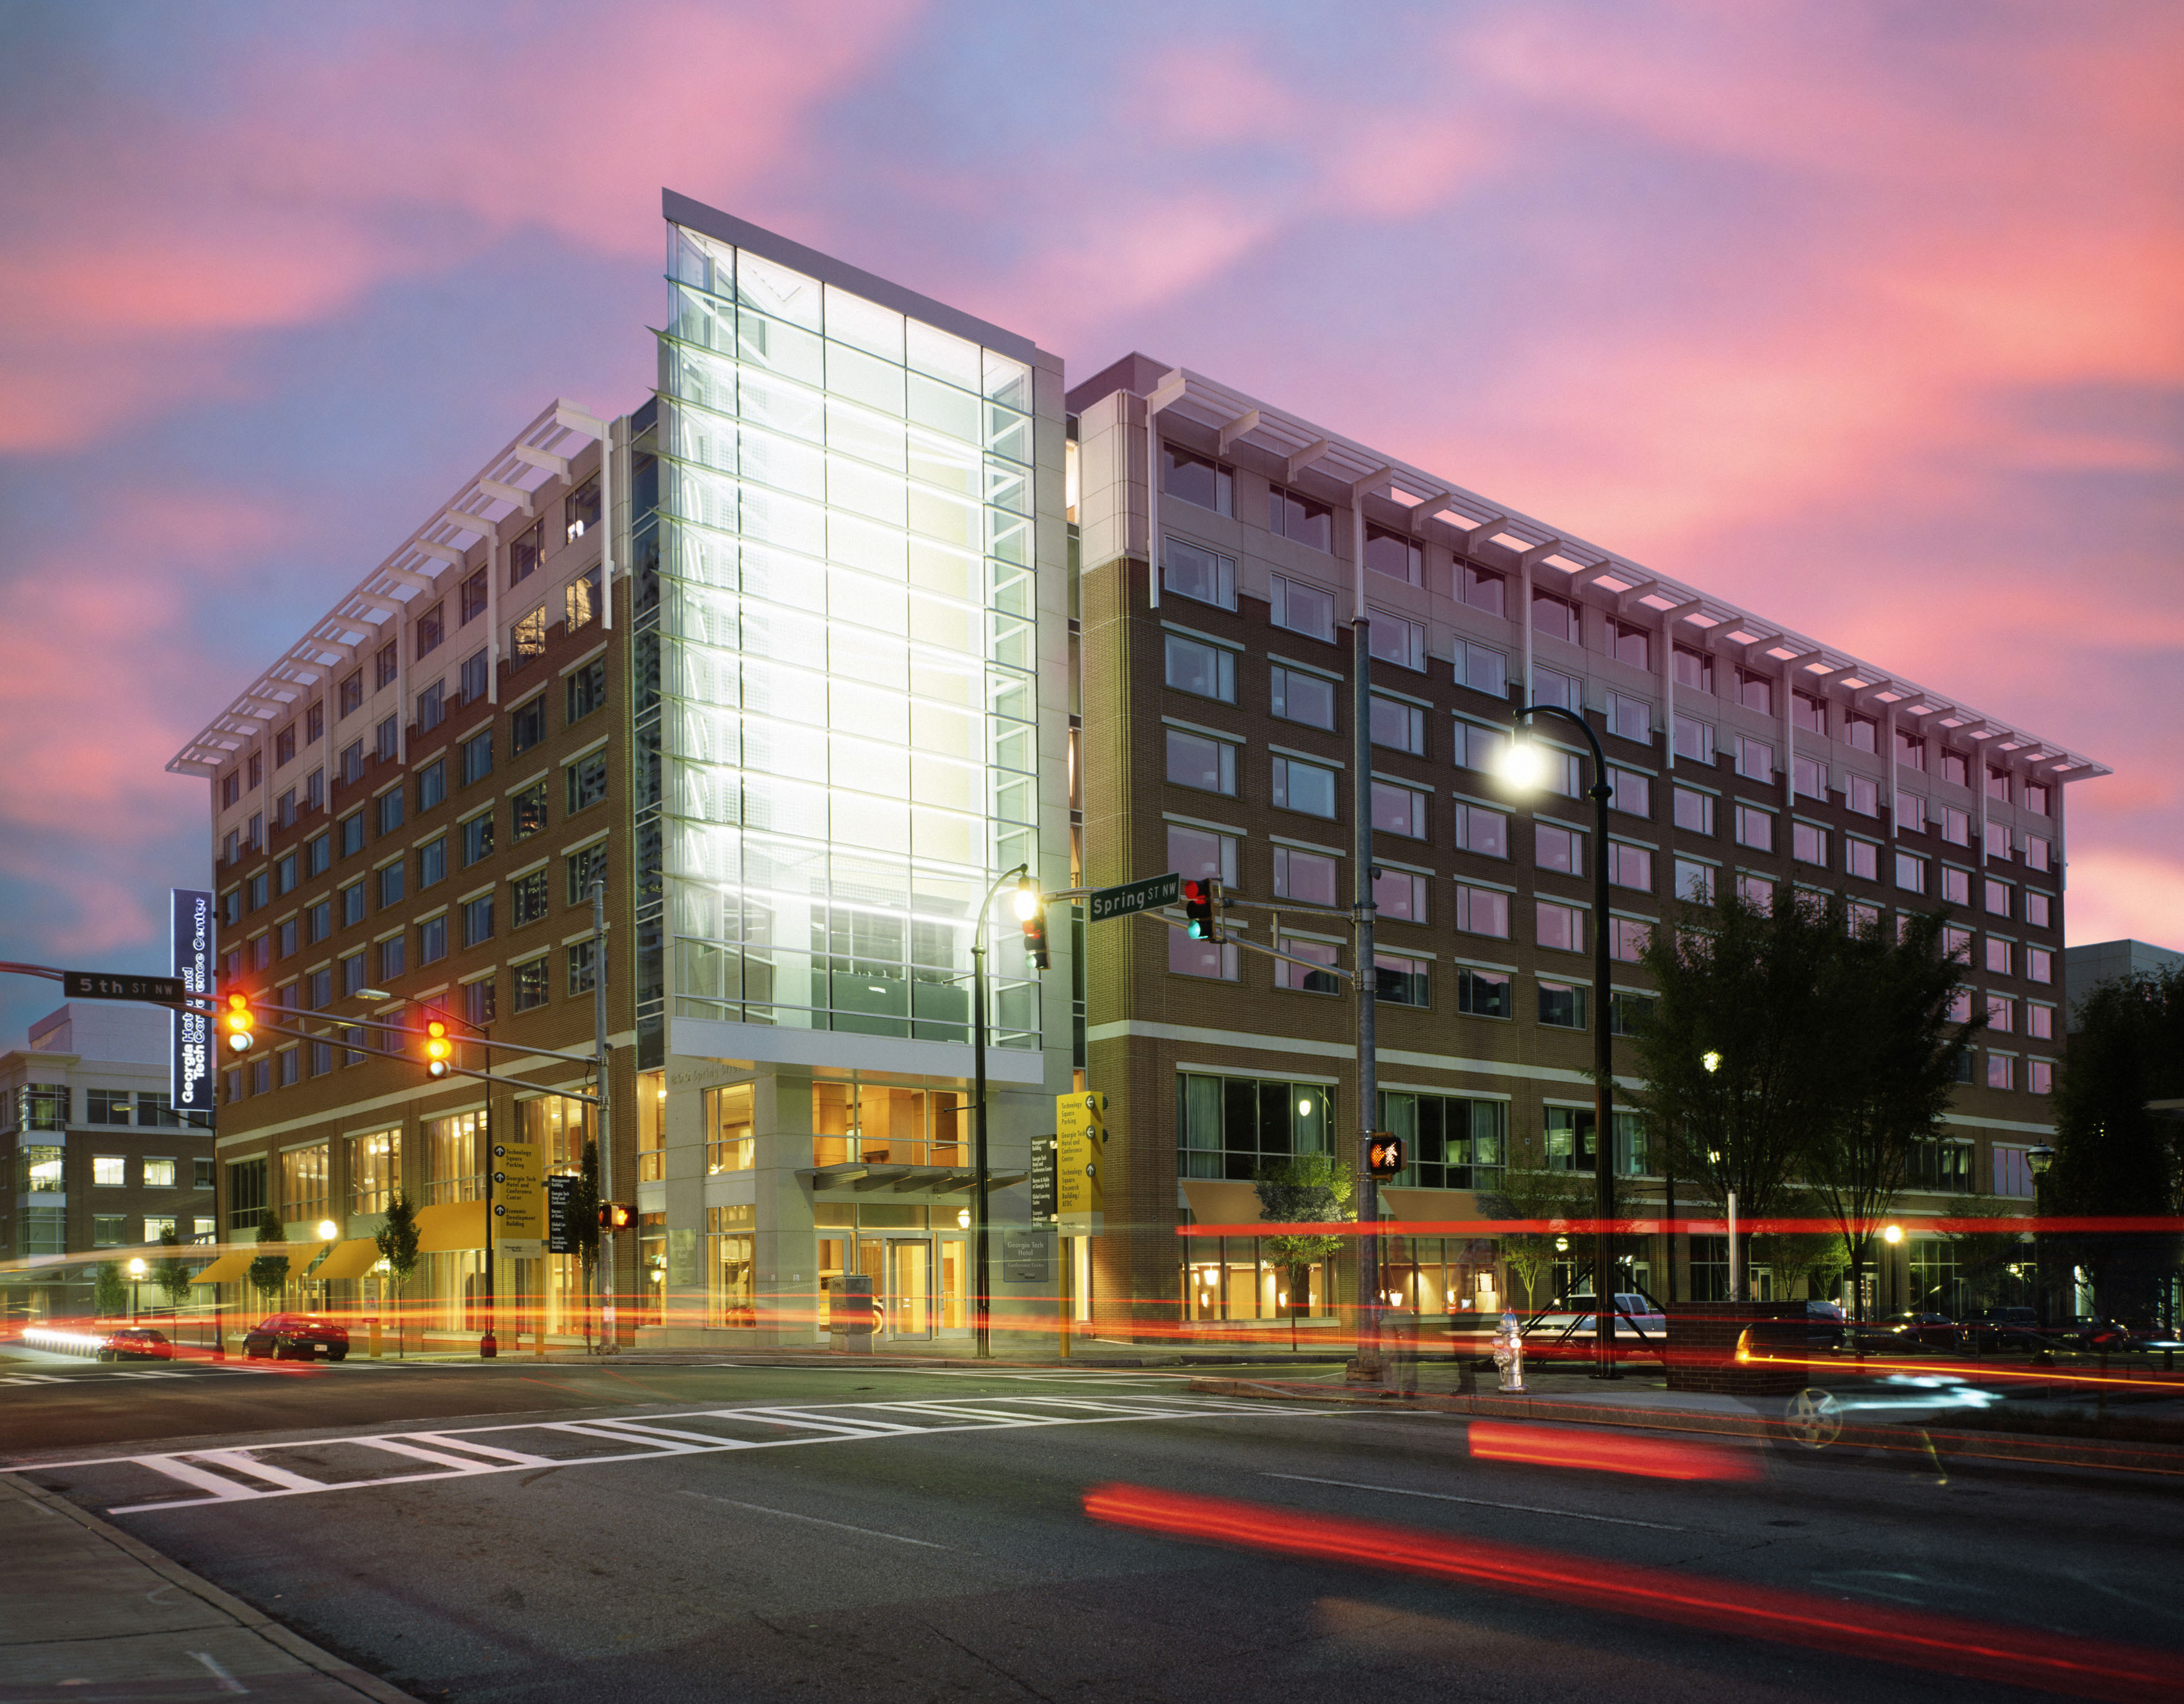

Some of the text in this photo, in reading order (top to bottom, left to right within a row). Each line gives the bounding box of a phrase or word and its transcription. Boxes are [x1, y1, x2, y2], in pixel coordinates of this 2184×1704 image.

[1094, 882, 1176, 915] Spring ST NW
[193, 898, 206, 951] Center
[80, 978, 173, 995] 5th ST NW
[193, 1044, 205, 1080] Tech
[182, 1044, 195, 1103] Georgia
[693, 1068, 718, 1083] Spring
[506, 1149, 532, 1157] Technology
[1062, 1191, 1080, 1200] Building/
[1008, 1241, 1030, 1250] Georgia
